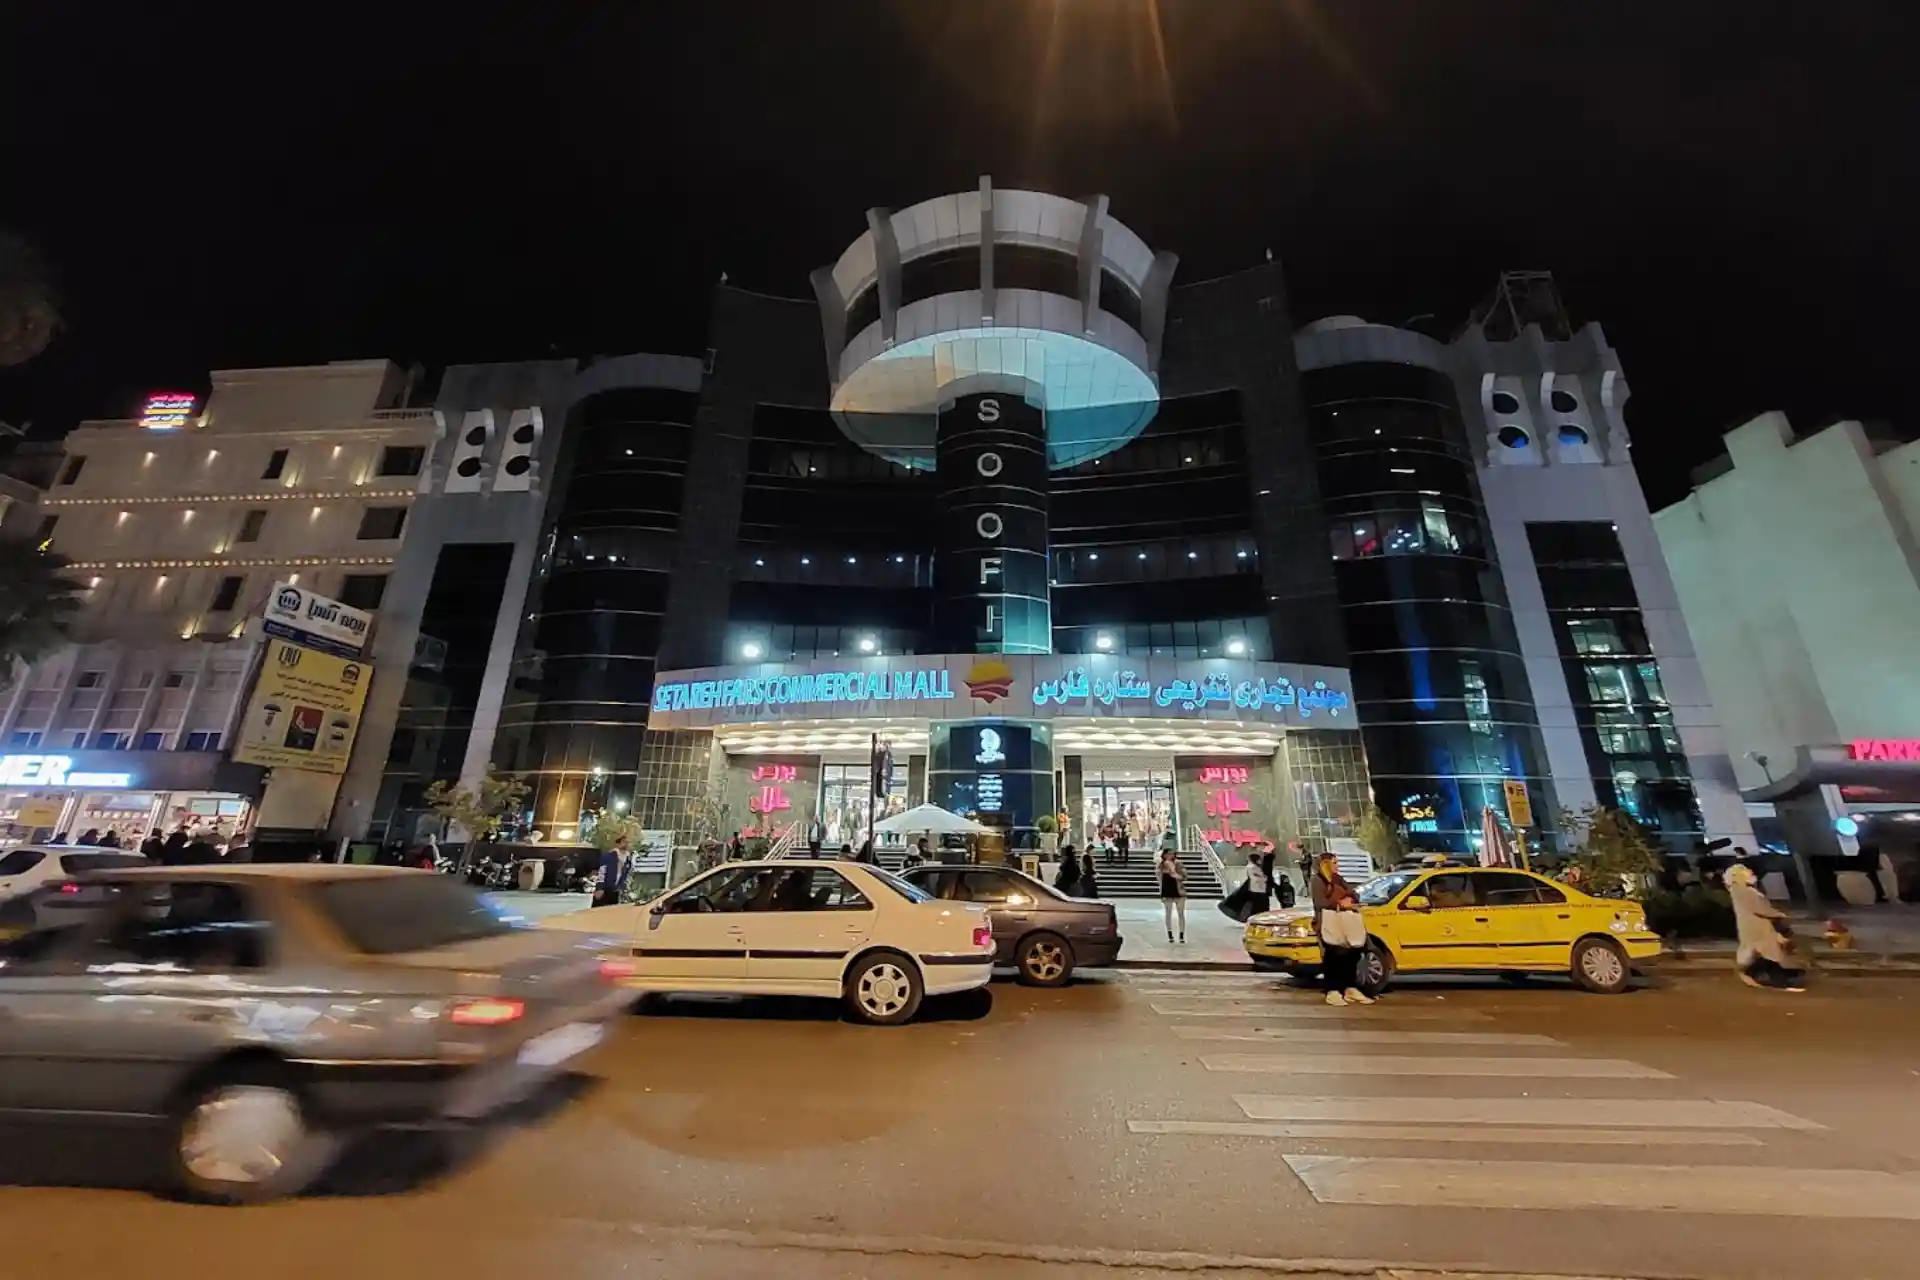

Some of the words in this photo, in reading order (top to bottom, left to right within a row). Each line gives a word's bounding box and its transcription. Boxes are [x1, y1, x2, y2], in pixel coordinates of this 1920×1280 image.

[653, 681, 720, 712] SETAREH
[720, 679, 762, 707] FARS
[765, 672, 893, 704] COMMERCIAL
[894, 670, 955, 700] MALL
[1032, 666, 1089, 705] فارس
[1094, 670, 1151, 704] ستاره
[1155, 671, 1232, 710] تفریحی
[1235, 677, 1296, 713] تجاری
[1297, 681, 1348, 717] مجتمع
[1200, 766, 1248, 784] بورس
